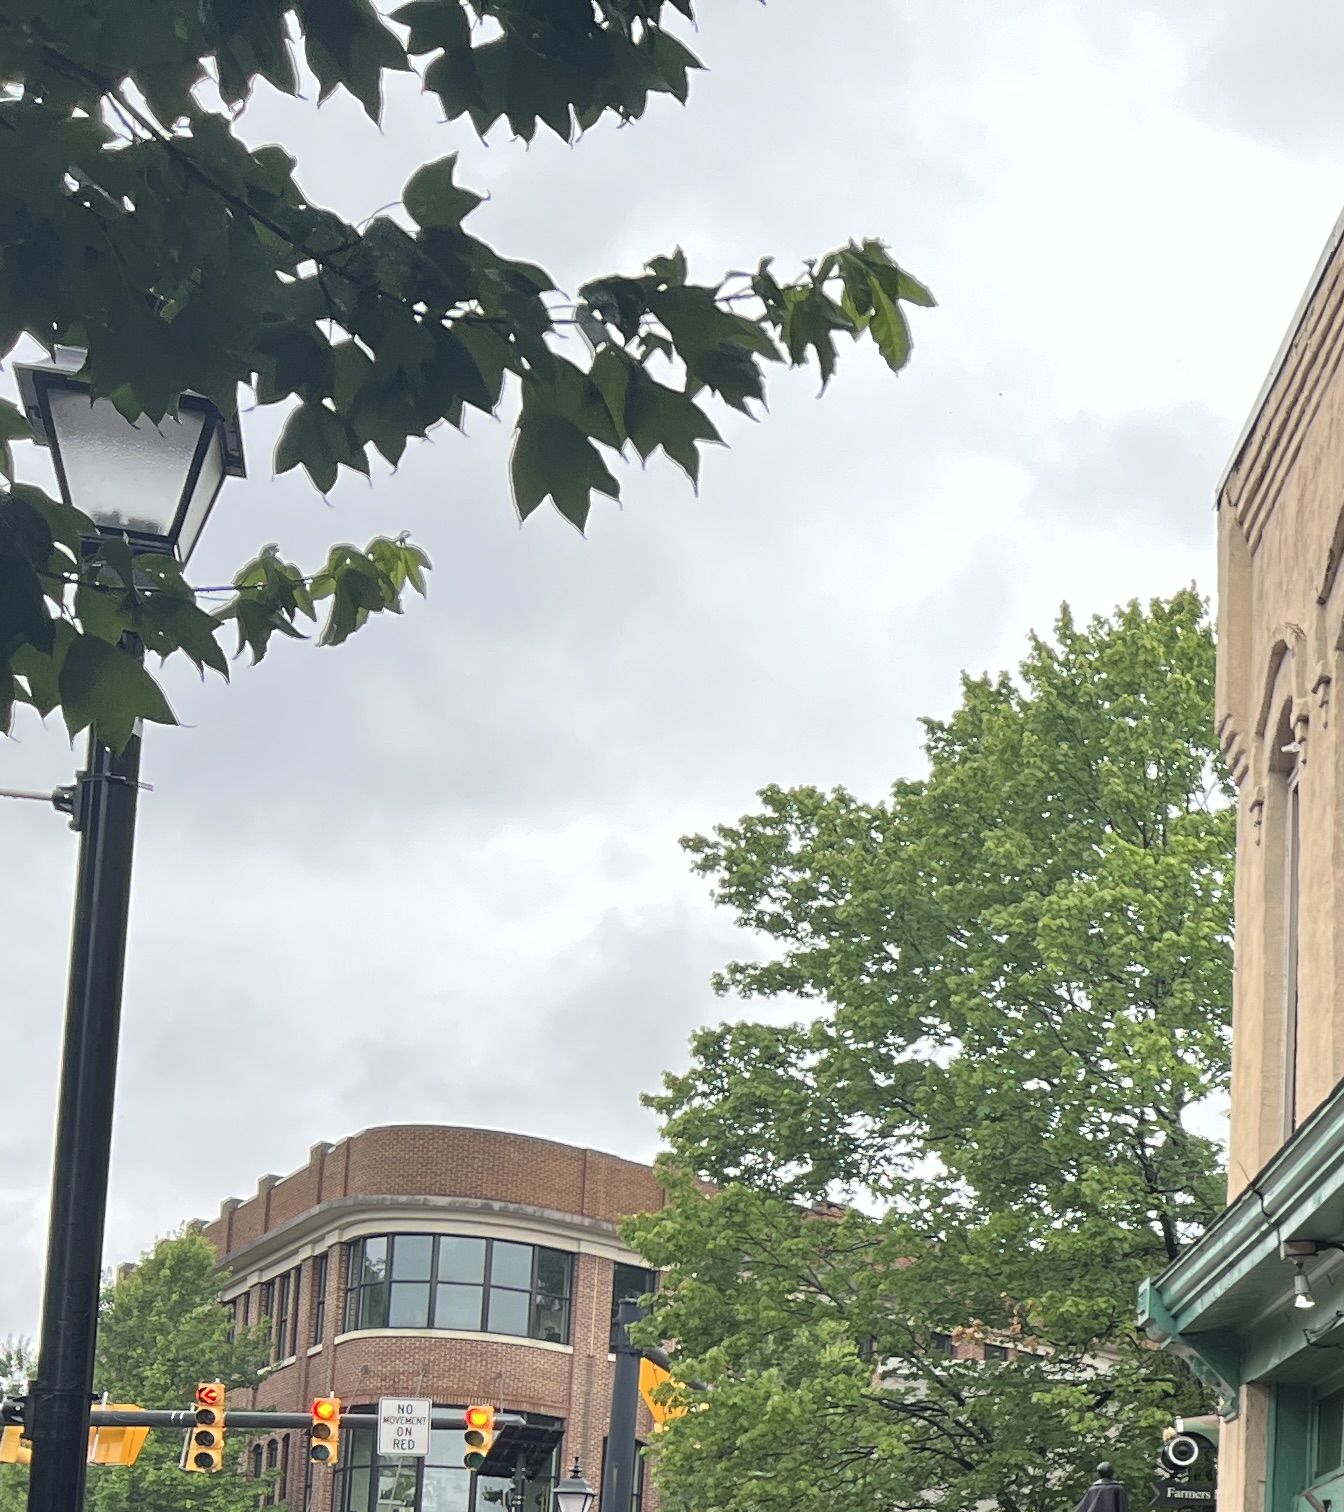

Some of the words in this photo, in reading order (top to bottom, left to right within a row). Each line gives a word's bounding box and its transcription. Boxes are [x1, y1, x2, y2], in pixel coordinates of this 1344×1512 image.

[397, 1404, 413, 1415] NO
[382, 1416, 427, 1425] MOVEMENT
[396, 1427, 412, 1438] ON
[392, 1438, 415, 1450] RED
[1166, 1487, 1211, 1500] Farmers
